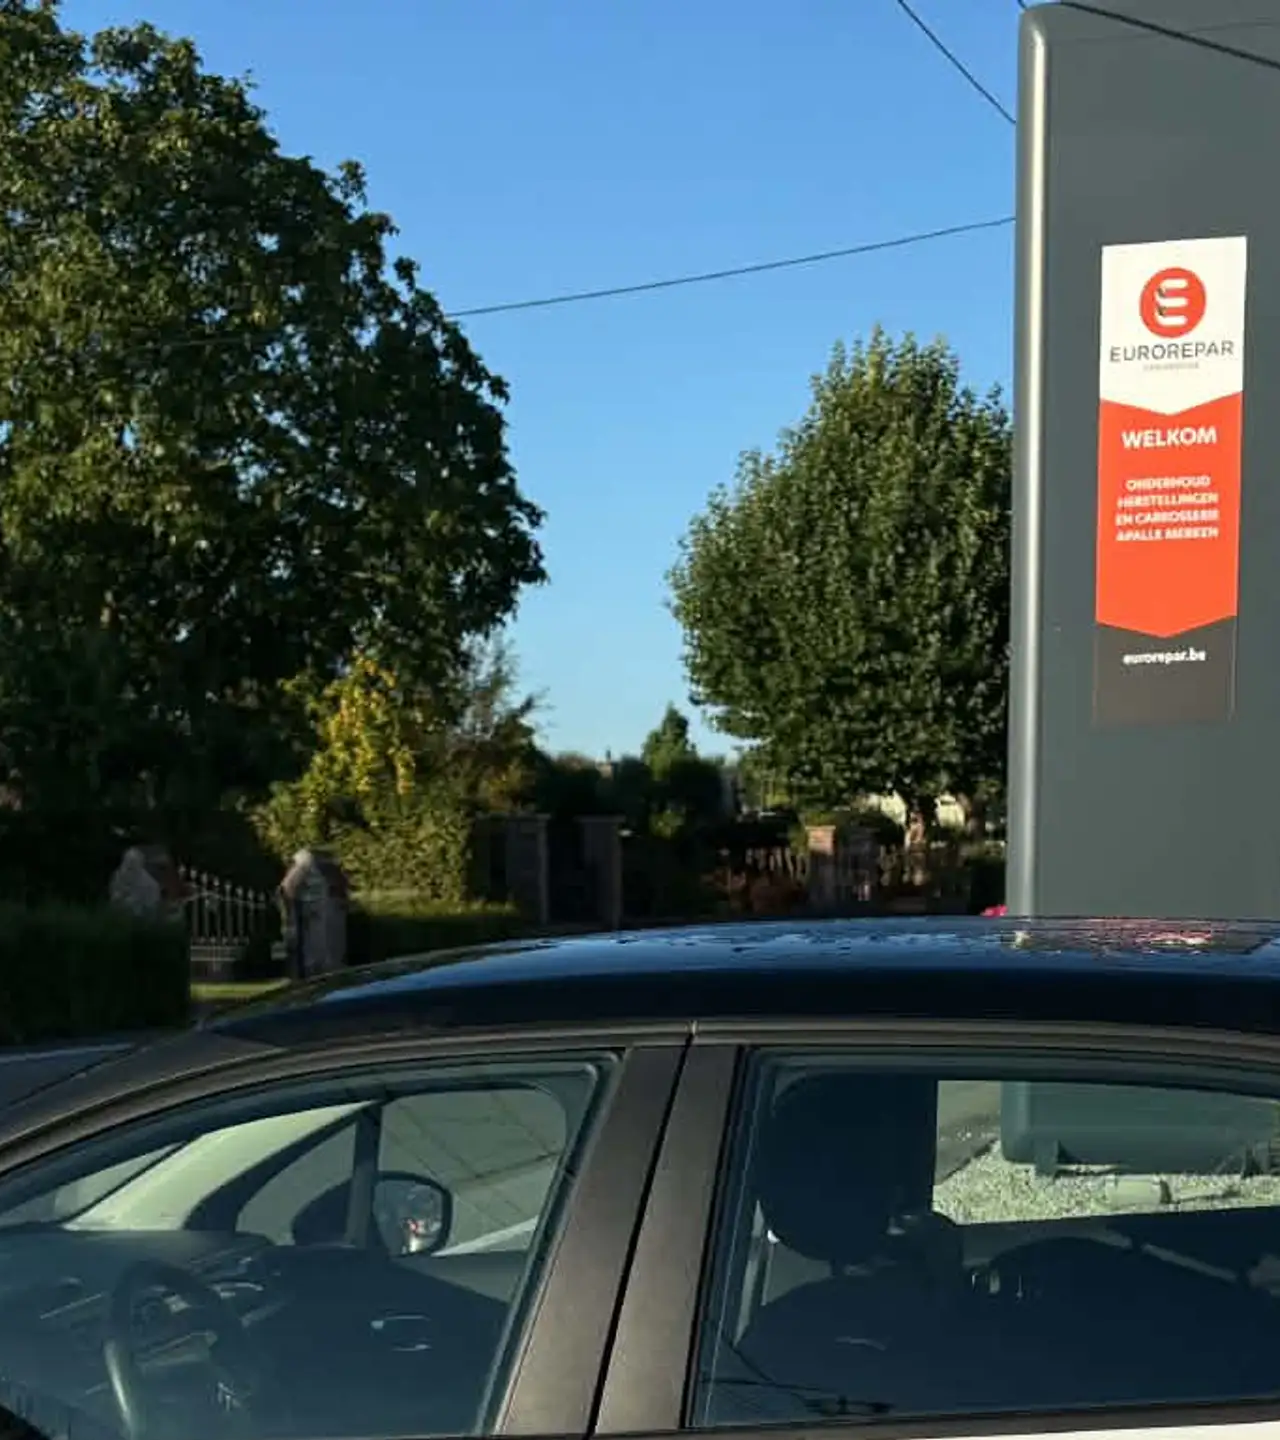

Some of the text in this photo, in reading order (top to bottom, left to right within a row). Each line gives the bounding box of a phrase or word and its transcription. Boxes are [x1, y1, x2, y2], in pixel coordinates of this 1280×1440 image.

[1109, 340, 1234, 363] EUROREPAR
[1122, 426, 1217, 449] WELKOM
[1123, 647, 1206, 666] eurorepar.be
